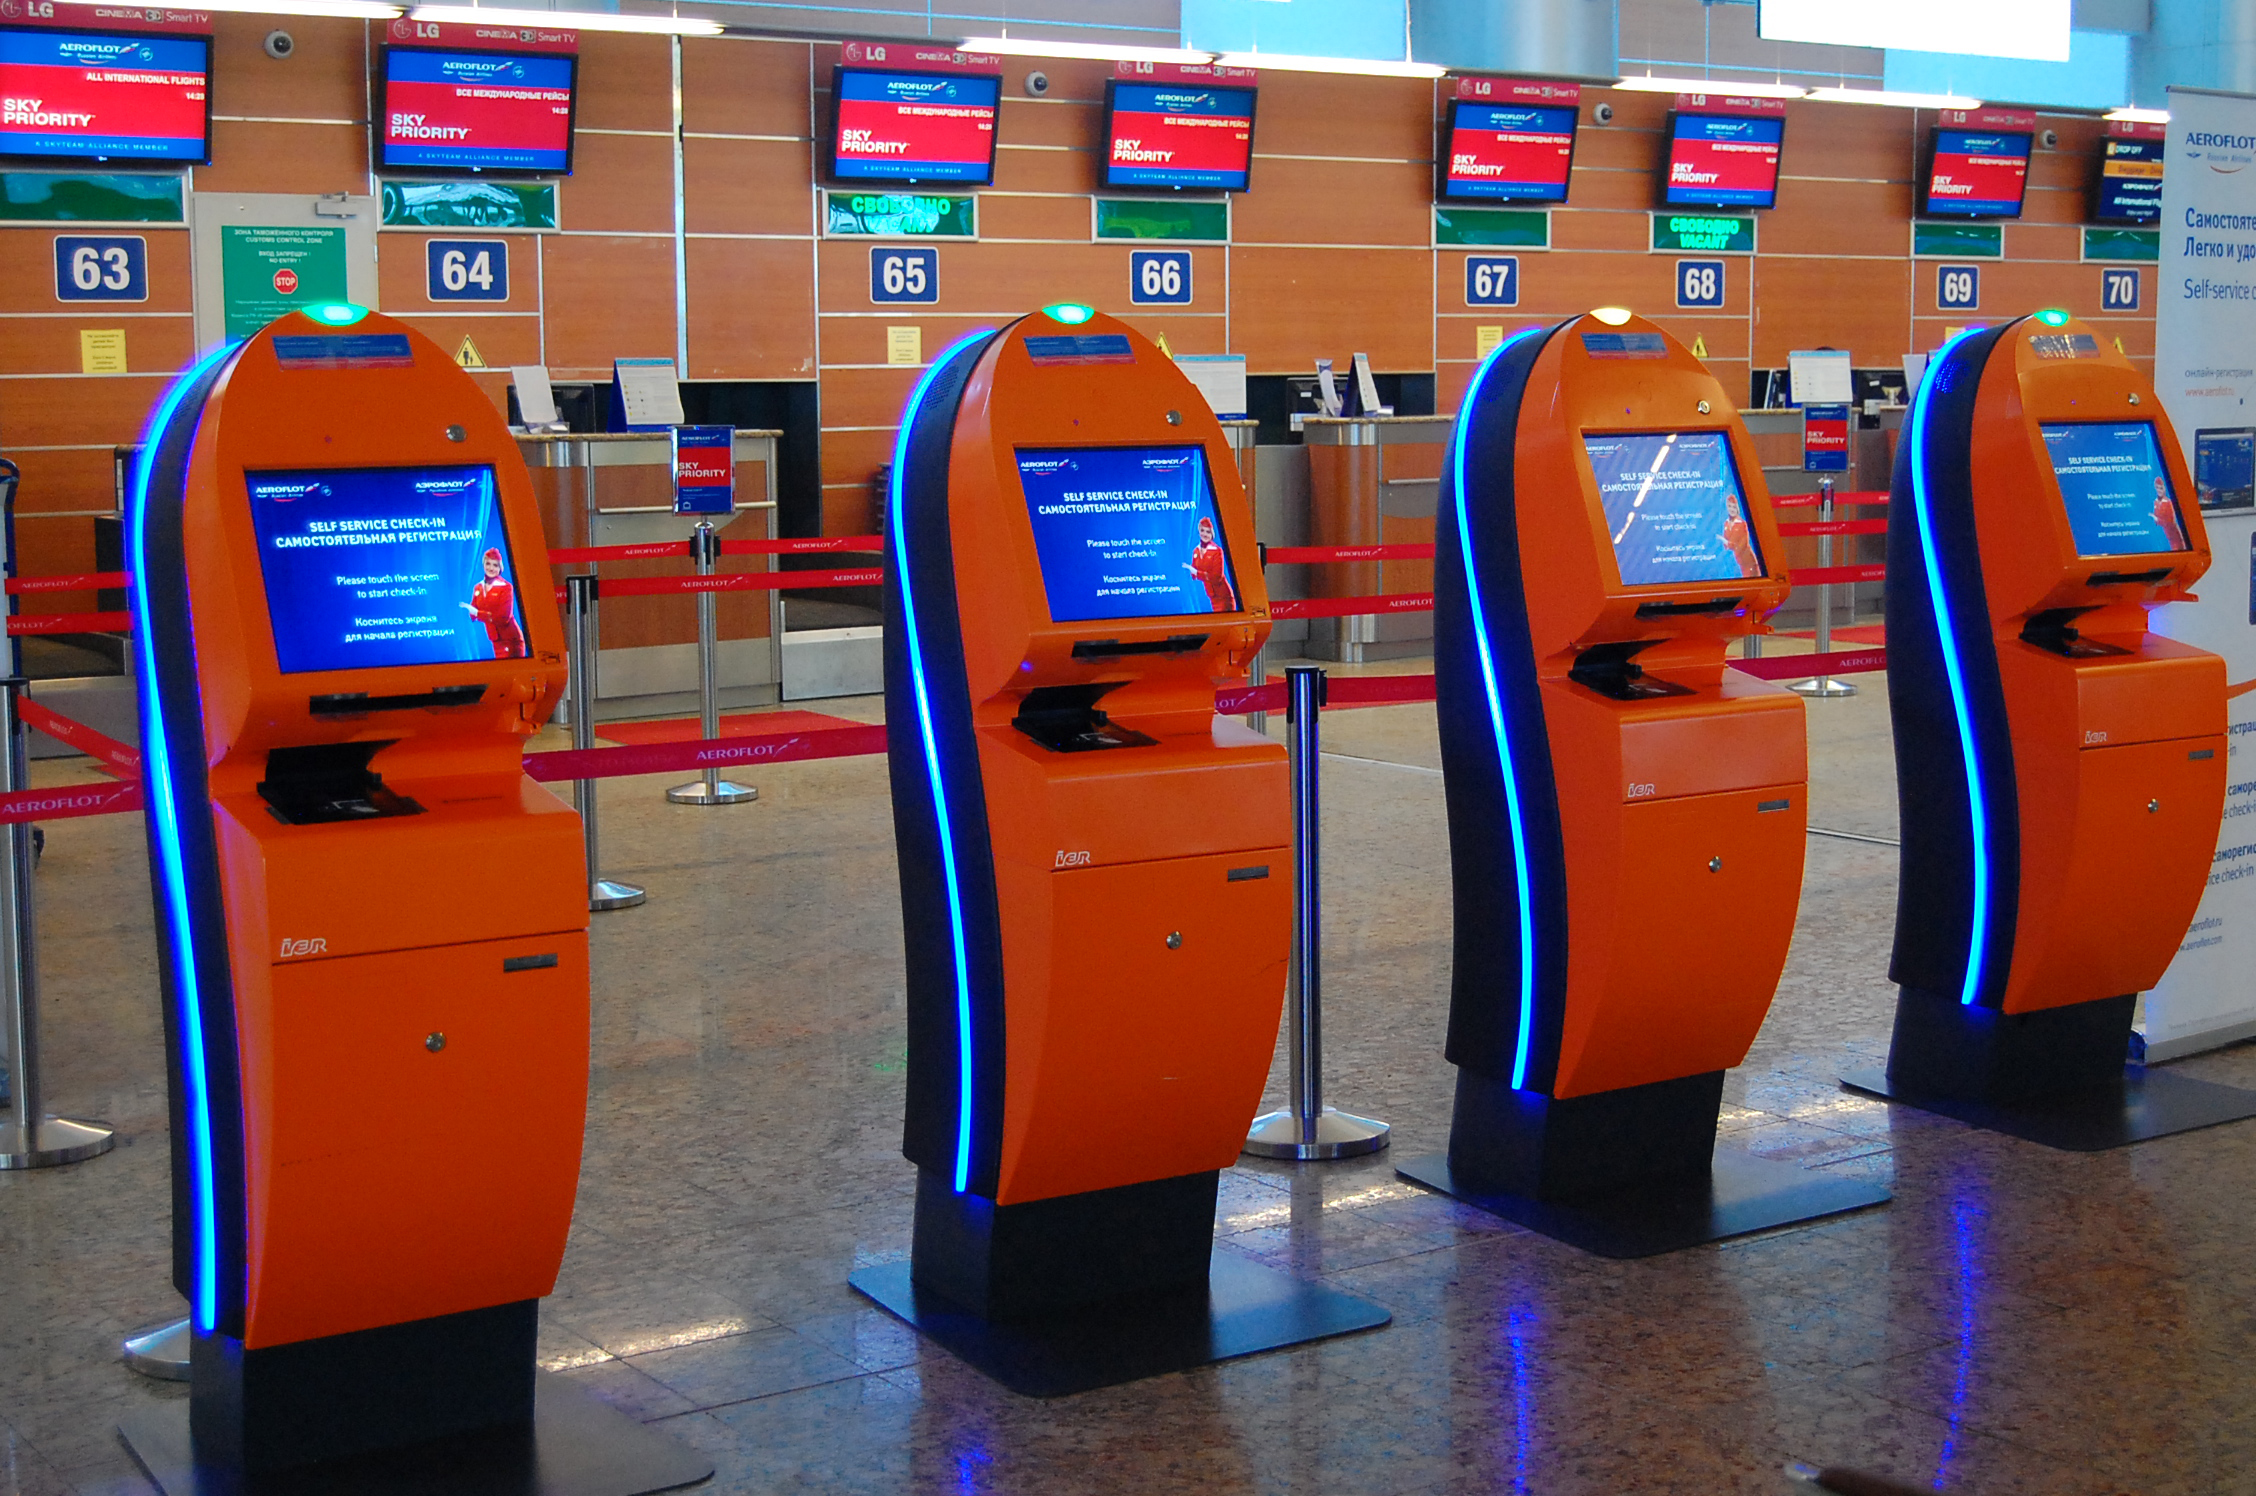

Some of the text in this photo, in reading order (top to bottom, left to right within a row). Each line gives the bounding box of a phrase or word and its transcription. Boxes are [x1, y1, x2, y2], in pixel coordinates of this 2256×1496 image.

[28, 3, 54, 18] LG
[166, 11, 192, 23] Smart
[195, 14, 208, 23] TV
[417, 23, 439, 38] LG
[538, 32, 561, 42] Smart
[564, 34, 576, 43] TV
[59, 43, 120, 53] AEROFLOT
[866, 46, 886, 61] LG
[968, 55, 988, 64] Smart
[443, 62, 496, 71] AEROFLOT
[1136, 62, 1154, 74] LG
[86, 72, 205, 86] ALL INTERNATIONAL FLIGHTS
[1246, 69, 1256, 77] TV
[456, 88, 472, 97] ВСЕ
[887, 82, 933, 91] AEROFLOT
[1475, 82, 1491, 95] LG
[3, 98, 42, 112] SKY
[1692, 94, 1706, 106] LG
[3, 112, 91, 127] PRIORITY
[391, 114, 425, 126] SKY
[391, 126, 468, 140] PRIORITY
[842, 129, 872, 141] SKY
[45, 141, 84, 149] SKYTEAM
[1115, 139, 1141, 150] SKY
[2185, 132, 2256, 149] AEROFLOT
[841, 141, 907, 154] PRIORITY
[1113, 150, 1172, 162] PRIORITY
[1453, 154, 1477, 165] SKY
[1452, 164, 1503, 176] PRIORITY
[1673, 162, 1694, 173] SKY
[1671, 172, 1717, 184] PRIORITY
[1670, 217, 1739, 235] СВОБОДНО
[1680, 233, 1729, 249] VACANT
[2184, 236, 2224, 257] Легко
[2226, 243, 2234, 257] и
[72, 246, 130, 290] 63
[441, 250, 494, 291] 64
[882, 256, 926, 295] 65
[1140, 259, 1181, 296] 66
[1474, 264, 1509, 298] 67
[276, 277, 296, 287] STOP
[1684, 268, 1716, 300] 68
[1944, 272, 1972, 303] 69
[2108, 276, 2133, 305] 70
[2184, 278, 2250, 300] Self-service
[679, 462, 699, 470] SKY
[679, 469, 726, 477] PRIORITY
[1620, 472, 1637, 481] SELF
[256, 486, 305, 494] AEROFLOT
[415, 481, 463, 489] АЭРОФЛОТ
[1063, 489, 1168, 502] SELF SERVICE CHECK-IN
[1038, 500, 1197, 515] САМОСТОЯТЕЛЬНАЯ РЕГИСТРАЦИЯ
[309, 517, 446, 533] SELF SERVICE CHECK-IN
[276, 530, 482, 548] САМОСТОЯТЕЛЬНАЯ РЕГИСТРАЦИЯ
[1087, 539, 1110, 547] Please
[1111, 538, 1130, 546] touch
[624, 547, 664, 556] AEROFLOT
[336, 573, 439, 586] Please touch the screen
[681, 579, 729, 588] AEROFLOT
[832, 573, 877, 582] AEROFLOT
[21, 580, 69, 589] AEROFLOT
[357, 587, 427, 599] to start check-in
[1389, 598, 1433, 608] AEROFLOT
[355, 616, 403, 627] Коснитесь
[345, 628, 454, 643] для начала регистрации
[696, 744, 775, 761] AEROFLOT
[2, 794, 104, 814] AEROFLOT
[2222, 864, 2254, 882] check-in
